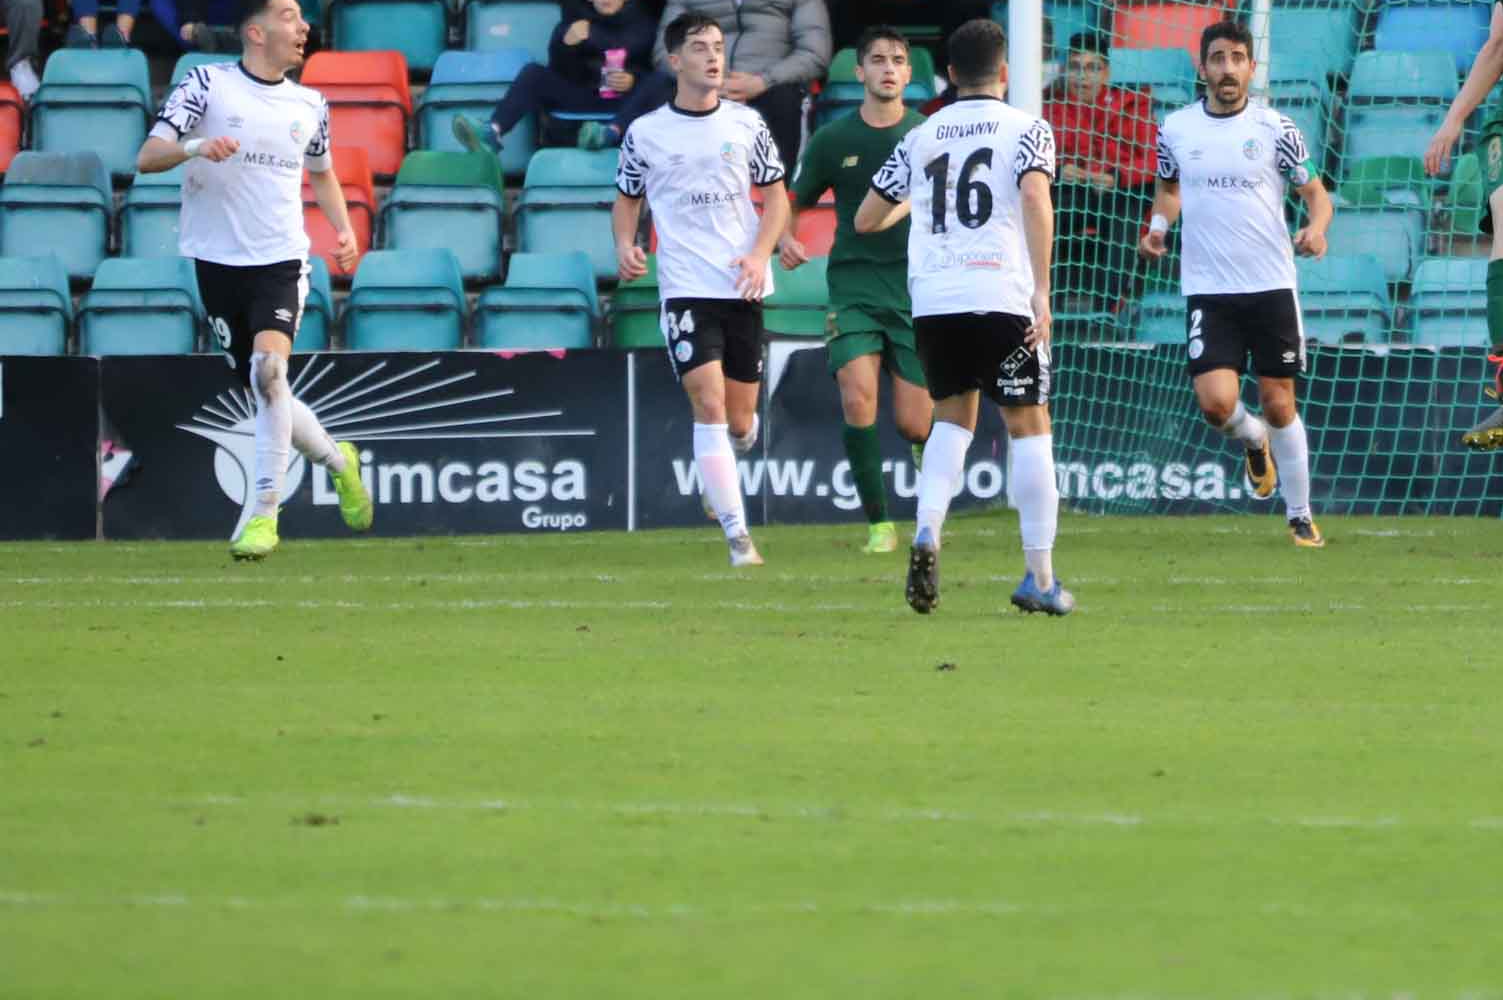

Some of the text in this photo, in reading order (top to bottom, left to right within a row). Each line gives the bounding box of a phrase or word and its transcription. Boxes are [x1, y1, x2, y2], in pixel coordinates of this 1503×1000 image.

[936, 121, 1000, 141] GIOVANNI
[924, 147, 993, 234] 16
[1189, 309, 1203, 339] 2
[521, 506, 587, 531] Grupo
